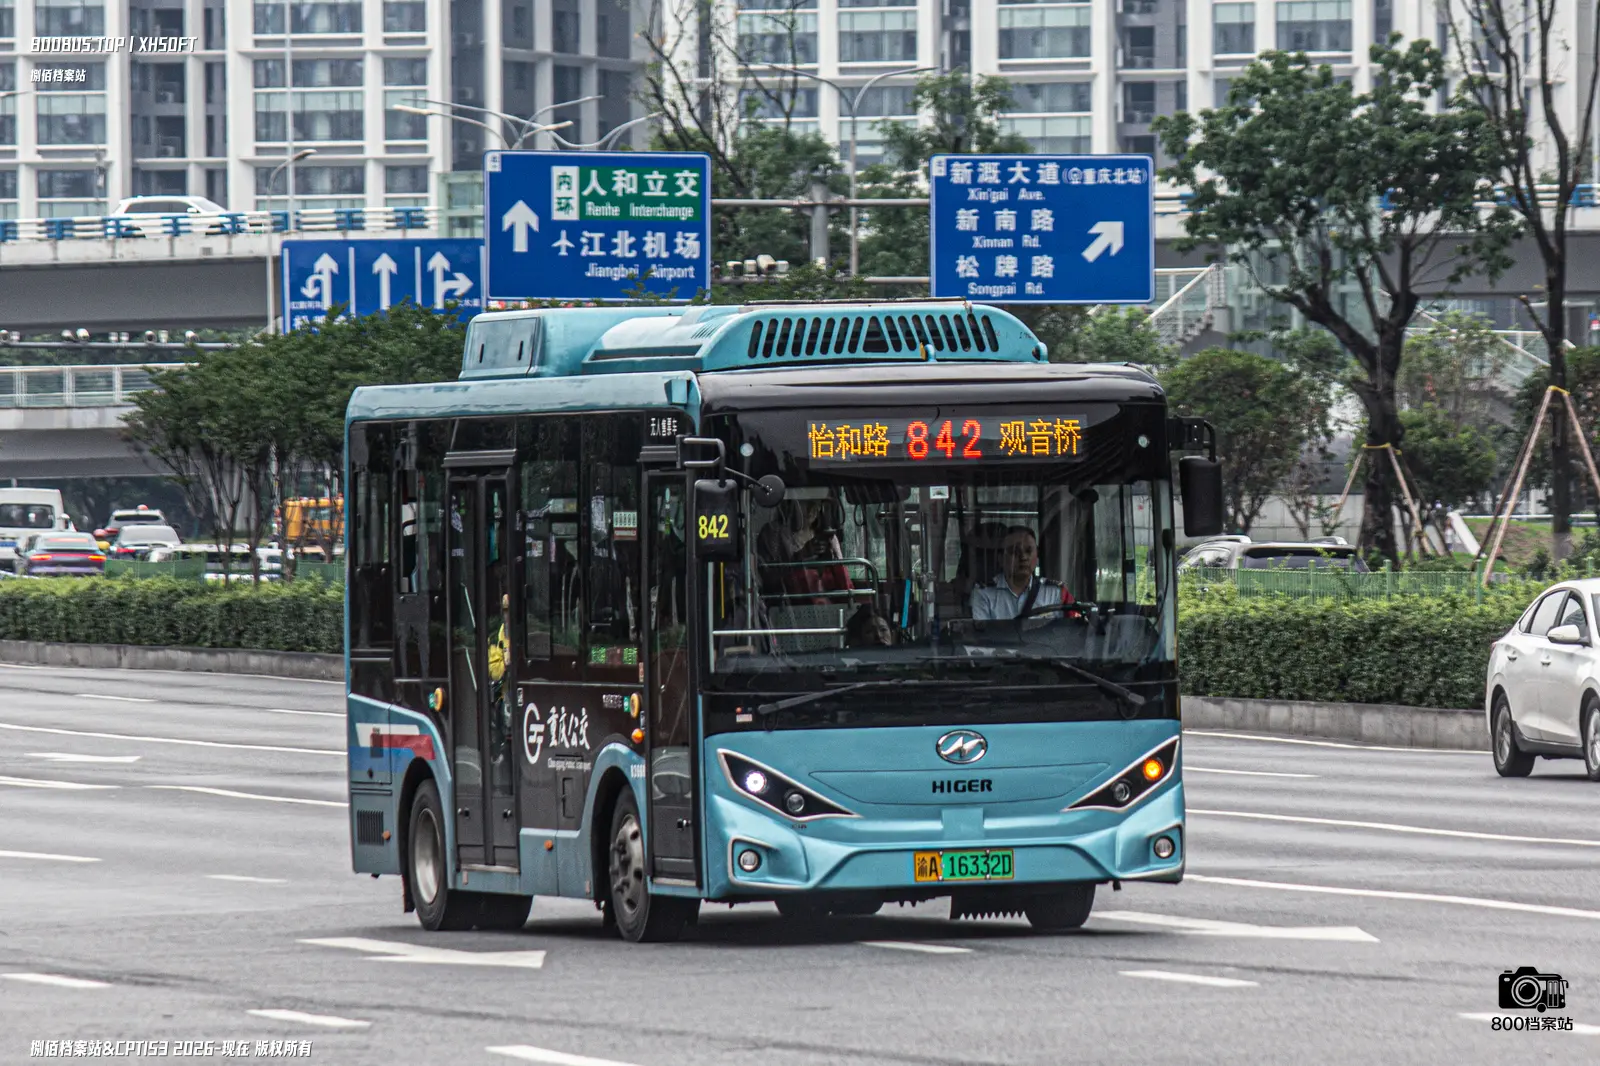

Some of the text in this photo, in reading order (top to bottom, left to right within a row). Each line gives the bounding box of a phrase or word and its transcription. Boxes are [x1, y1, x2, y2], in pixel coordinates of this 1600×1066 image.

[581, 169, 700, 197] 人和立交
[949, 161, 1060, 184] 新溉大道
[1018, 188, 1046, 200] Ave.
[585, 201, 694, 220] Renhe Interchange
[955, 208, 1055, 231] 新南路
[579, 230, 701, 259] 江北机场
[972, 234, 1041, 248] Xinnan Rd.
[649, 263, 695, 281] Airport
[955, 254, 1055, 278] 松牌路
[967, 282, 1045, 297] Songpai Rd.
[808, 417, 1082, 460] 怡和路 842 观音桥
[698, 514, 729, 539] 842
[547, 705, 591, 750] 重庆公交
[932, 779, 993, 793] HIGER
